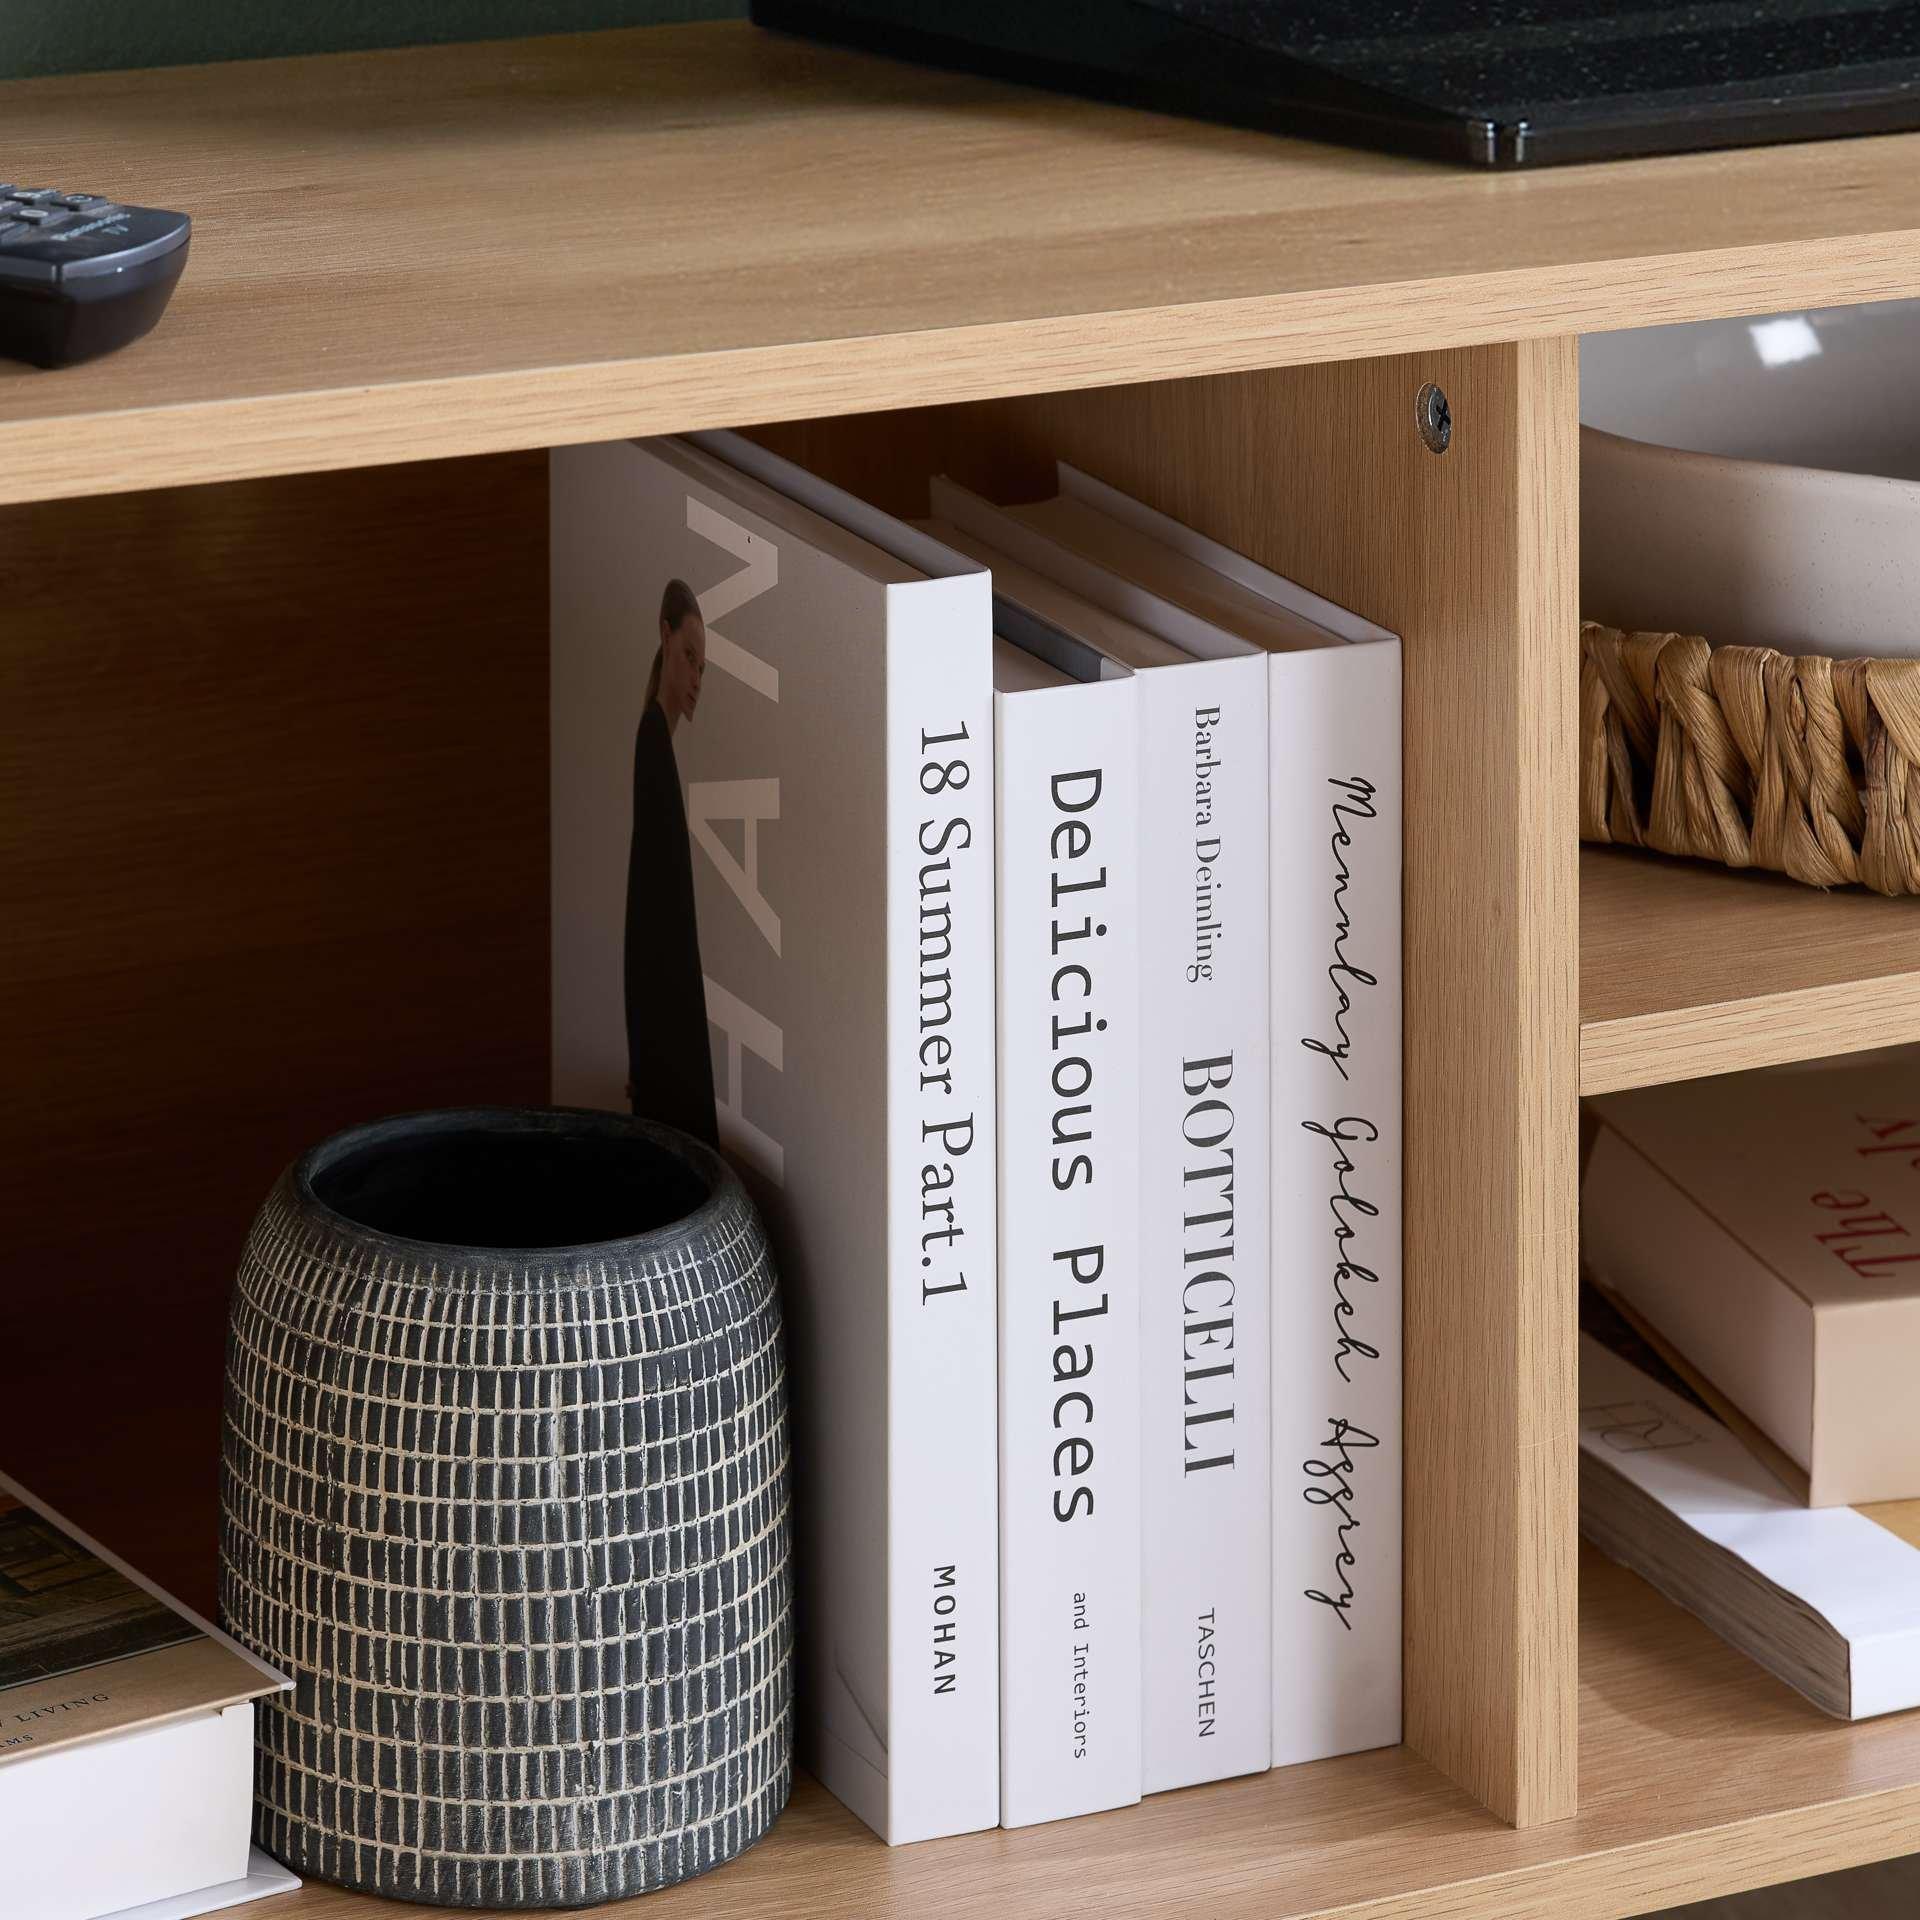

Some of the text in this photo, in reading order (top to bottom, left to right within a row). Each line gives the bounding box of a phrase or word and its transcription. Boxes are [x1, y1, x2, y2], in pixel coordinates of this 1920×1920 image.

[1183, 703, 1224, 985] Barbara Deimling
[918, 720, 975, 1307] 18 Summer Part.1
[1050, 767, 1109, 1523] Delicious Places
[1181, 1048, 1236, 1479] BOTTICELLI
[1300, 1116, 1381, 1384] Golokeh
[931, 1564, 957, 1695] MOHAN
[1302, 1417, 1381, 1632] Aggrey
[14, 1693, 110, 1723] LIVING
[1071, 1591, 1091, 1760] and Interiors
[1197, 1606, 1216, 1738] TASCHEN
